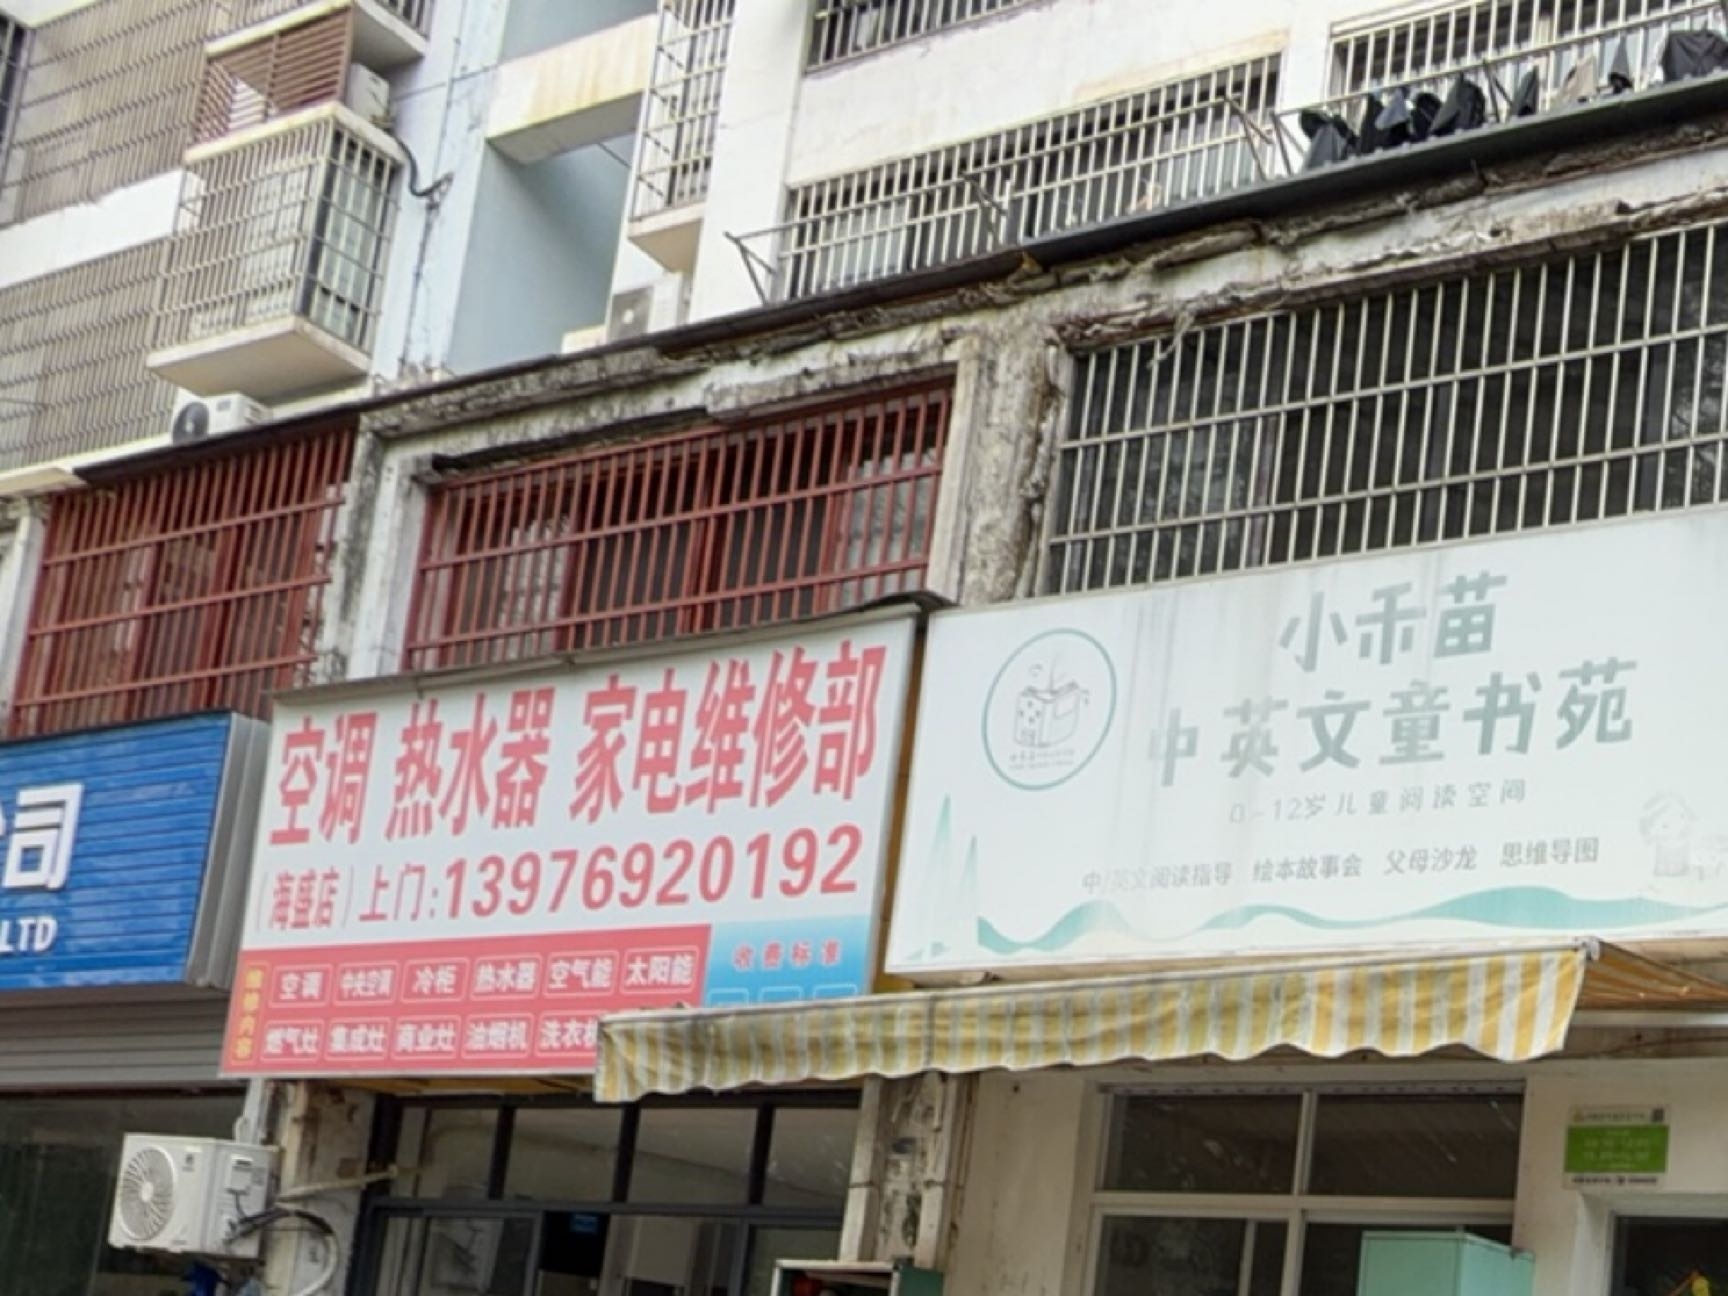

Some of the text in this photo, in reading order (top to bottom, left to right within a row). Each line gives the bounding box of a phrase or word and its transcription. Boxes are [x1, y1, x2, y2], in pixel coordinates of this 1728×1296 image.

[1278, 570, 1510, 674] 小禾苗
[269, 639, 887, 845] 空调 热水器 家电维修部
[1149, 655, 1637, 789] 中英文童书苑
[0, 783, 84, 889] 司
[1253, 851, 1363, 883] 绘本故事会
[1383, 844, 1478, 875] 父母沙龙
[1500, 836, 1599, 868] 思维导图
[0, 917, 58, 952] LTD
[279, 970, 323, 1000] 空调
[412, 964, 457, 994] 冷柜
[474, 959, 538, 993] 热水器
[548, 957, 613, 988] 空气能
[625, 953, 694, 987] 太阳能
